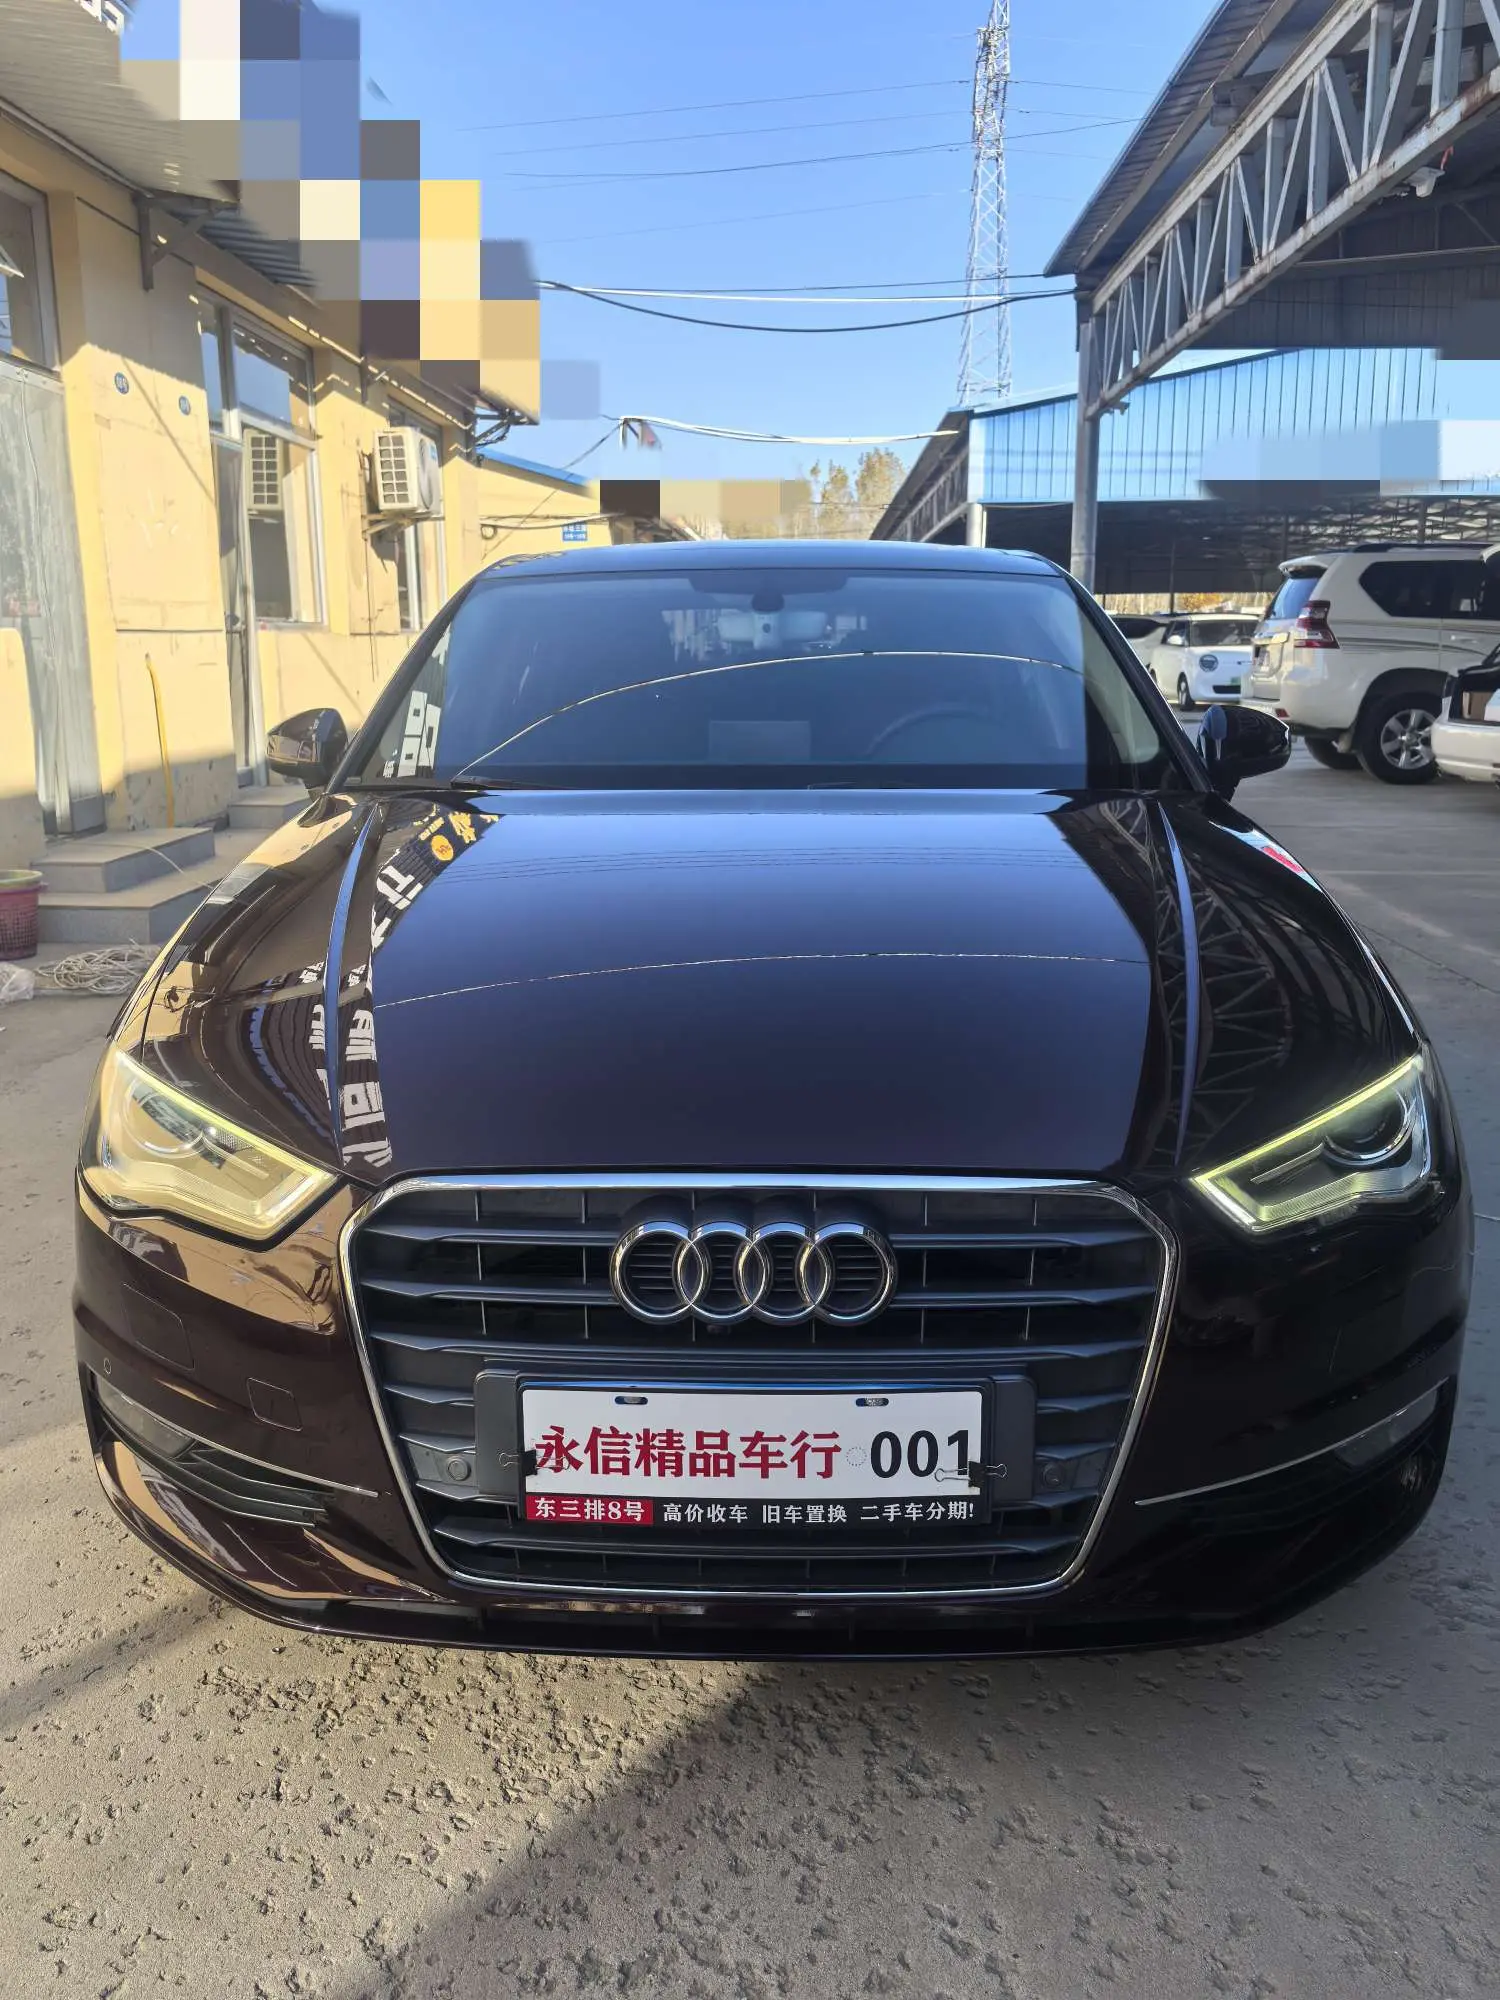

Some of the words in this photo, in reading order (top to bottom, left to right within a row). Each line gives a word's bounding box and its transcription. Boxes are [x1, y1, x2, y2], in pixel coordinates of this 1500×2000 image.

[535, 1425, 842, 1479] 永信精品车行
[870, 1430, 969, 1479] 001
[534, 1497, 645, 1522] 东三排8号
[662, 1502, 748, 1524] 高价收车
[762, 1504, 847, 1524] 旧车置换
